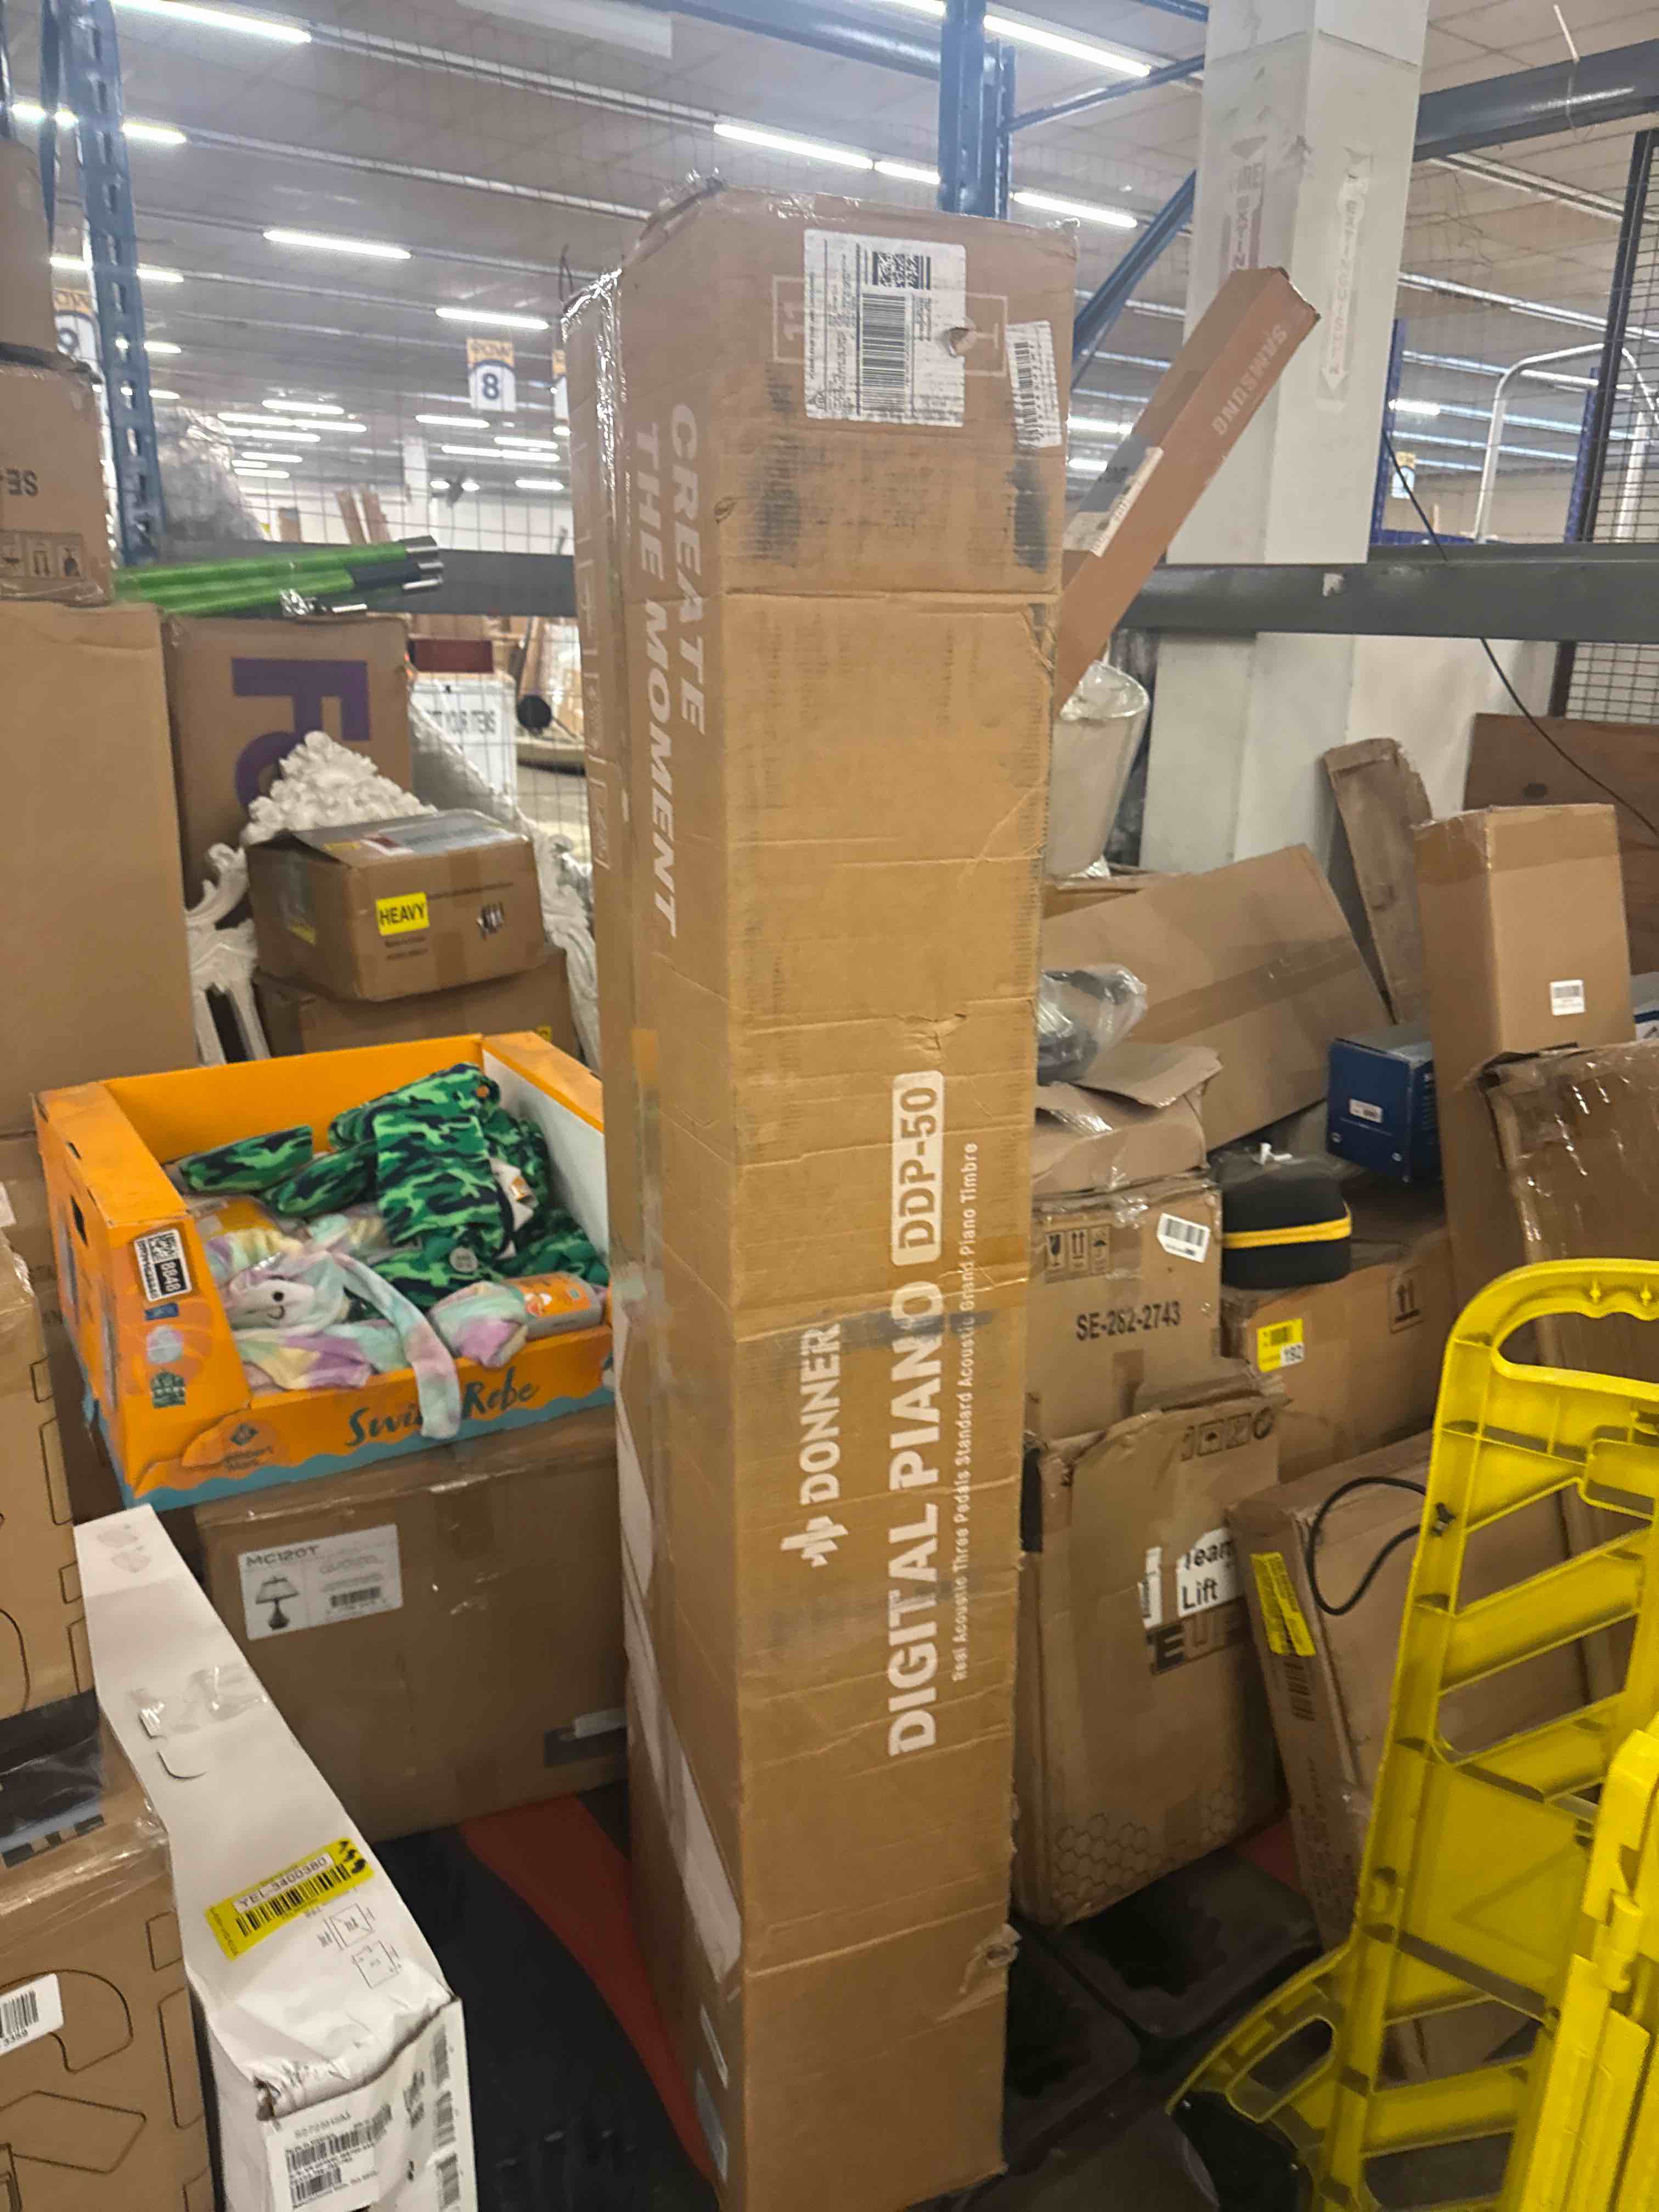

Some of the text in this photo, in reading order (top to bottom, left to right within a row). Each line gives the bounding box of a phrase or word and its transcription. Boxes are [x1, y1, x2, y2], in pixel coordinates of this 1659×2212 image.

[483, 373, 499, 400] 8
[1211, 324, 1288, 436] SAMSUNG
[672, 404, 706, 735] CREATE
[637, 421, 676, 938] THE MOMENT
[379, 903, 426, 926] HEAVY
[961, 1142, 978, 1206] Timbre
[961, 1211, 977, 1255] Piano
[960, 1257, 977, 1313] Grand
[1076, 1301, 1181, 1341] SE-282-2743
[799, 1323, 840, 1505] DONNER
[888, 1086, 944, 1756] DIGITAL PIANO DDP-50
[955, 1392, 973, 1466] Standard
[954, 1470, 971, 1526] Pedals
[246, 1545, 318, 1565] MC120T
[953, 1527, 969, 1572] Three
[952, 1575, 969, 1643] Acoustic
[1182, 1578, 1217, 1610] Lift
[952, 1645, 968, 1681] Real
